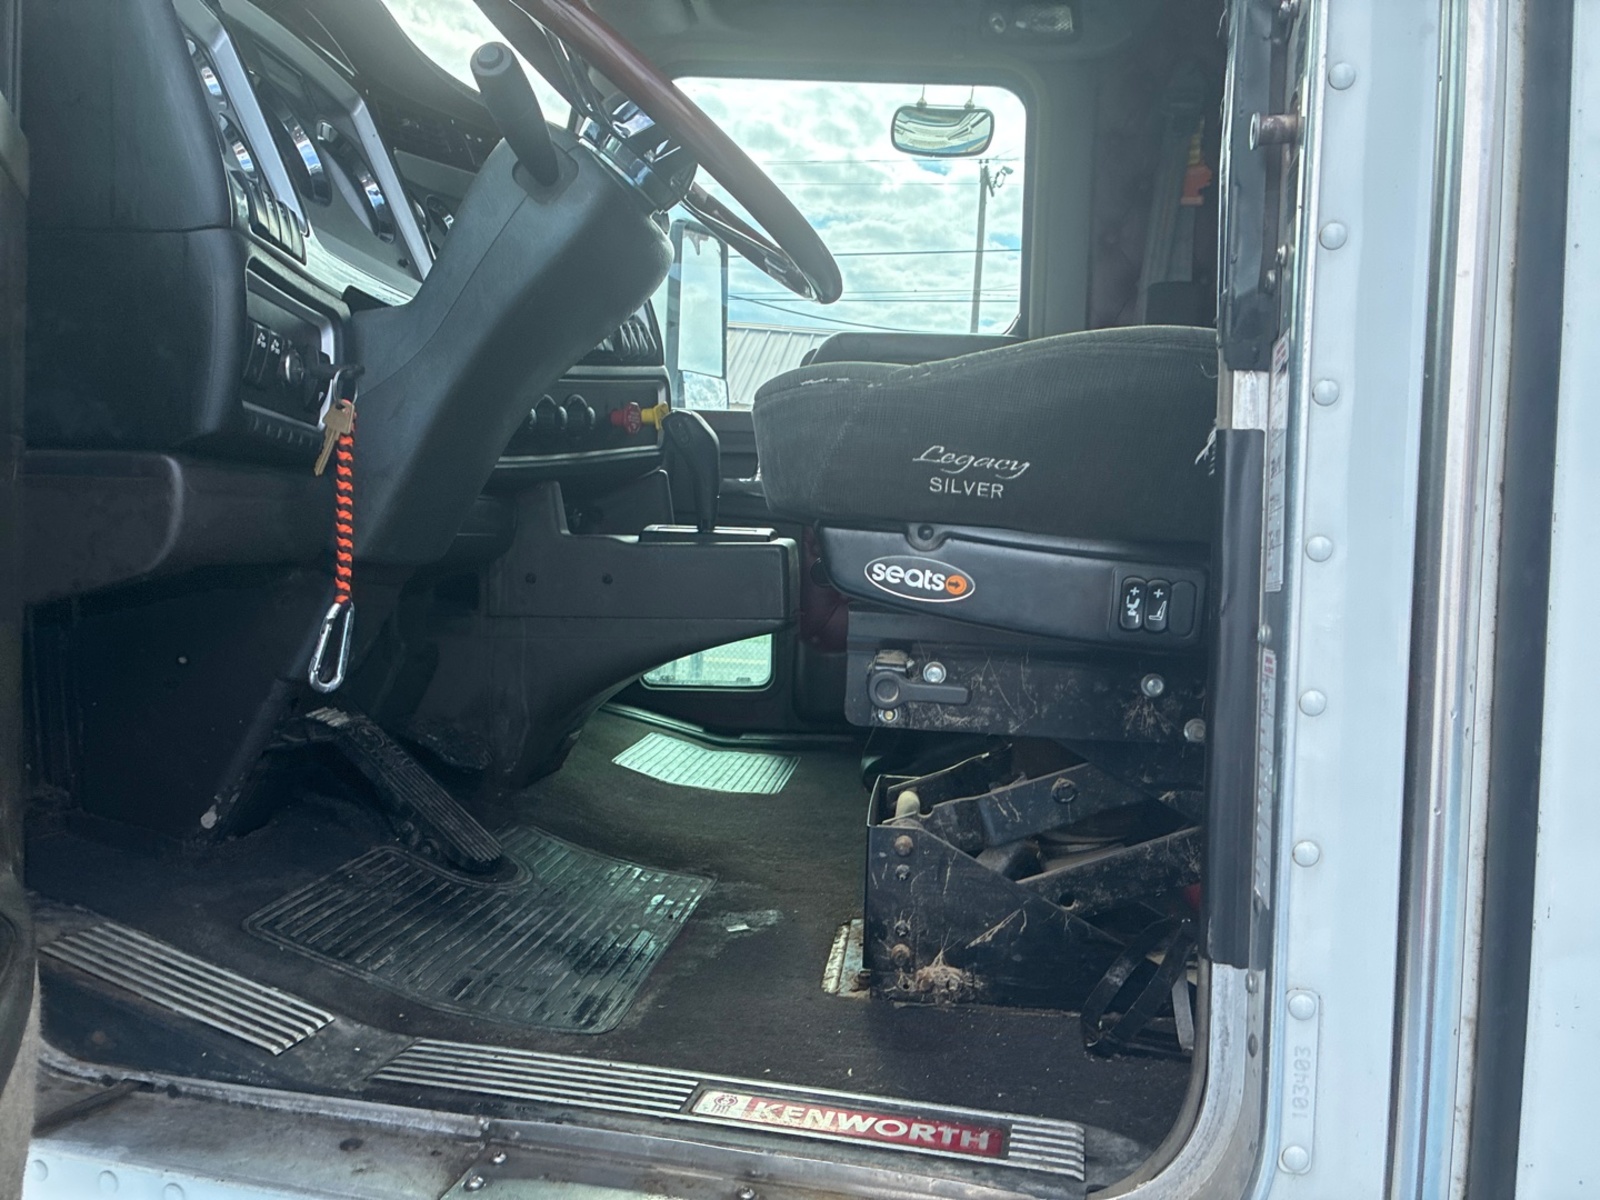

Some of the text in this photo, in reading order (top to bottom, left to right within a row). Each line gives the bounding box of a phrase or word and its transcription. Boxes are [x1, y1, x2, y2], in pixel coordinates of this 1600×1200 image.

[912, 445, 1030, 480] Legacy
[929, 477, 1004, 499] SILVER
[871, 562, 946, 592] seats
[752, 1101, 991, 1151] KENWORTH
